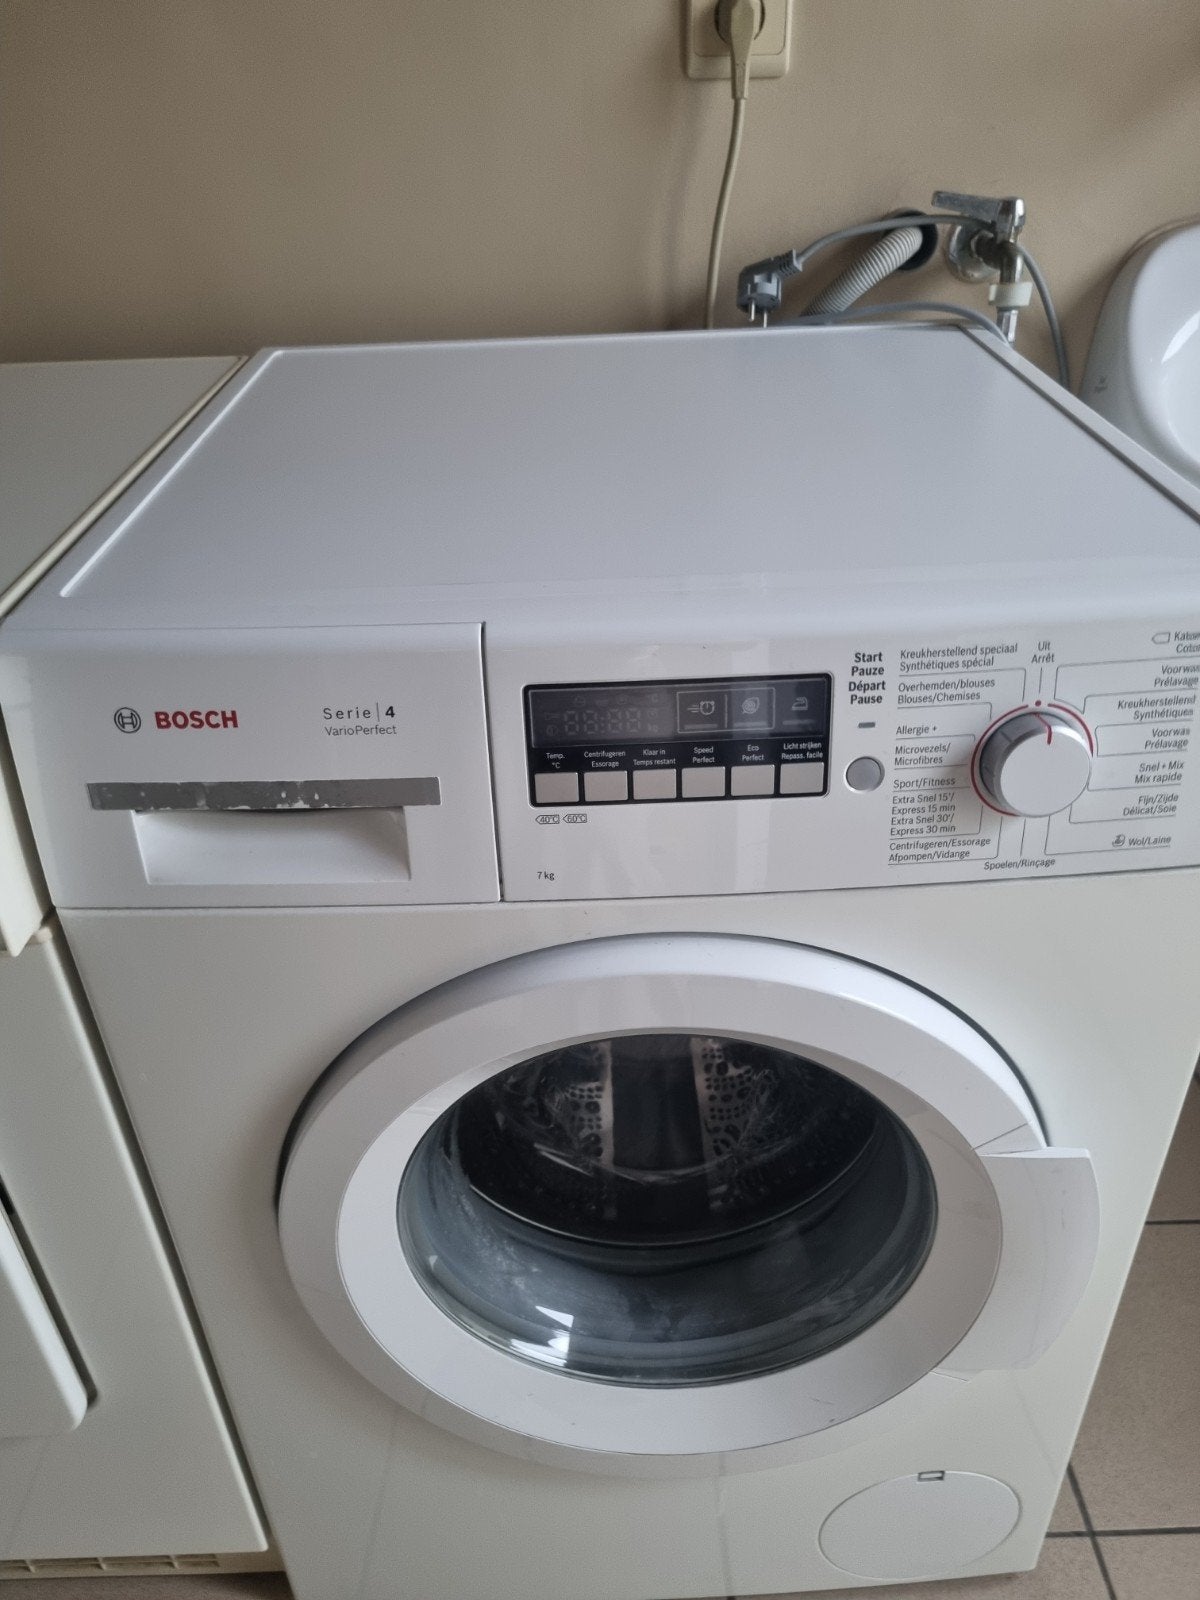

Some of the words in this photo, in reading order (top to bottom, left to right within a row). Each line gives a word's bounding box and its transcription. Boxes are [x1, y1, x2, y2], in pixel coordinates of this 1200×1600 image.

[900, 646, 978, 659] Kreukherstellend
[980, 643, 1018, 657] speciaal
[1038, 641, 1051, 651] Uit
[854, 652, 883, 663] Start
[1031, 653, 1055, 664] Arrêt
[900, 660, 960, 673] Synthétiques
[961, 657, 995, 670] spécial
[851, 665, 884, 677] Pauze
[848, 680, 886, 693] Départ
[898, 679, 995, 692] Overhemden/blouses
[1154, 676, 1199, 687] Prélavage
[850, 694, 883, 705] Pause
[897, 692, 981, 705] Blouses/Chemises
[1118, 695, 1196, 710] Kreukherstellend
[323, 706, 371, 720] Serie
[385, 706, 395, 718] 4
[1133, 709, 1194, 722] Synthétiques
[154, 710, 239, 729] BOSCH
[325, 724, 397, 736] VarioPerfect
[896, 726, 930, 737] Allergie
[1152, 728, 1190, 739] Voorwas
[747, 744, 760, 752] Eco
[783, 742, 799, 751] Licht
[800, 741, 822, 751] strijken
[895, 743, 951, 755] Microvezels/
[1145, 739, 1189, 750] Prélavage
[546, 752, 565, 761] Temp.
[584, 750, 626, 759] Centrifugeren
[643, 748, 658, 756] Klaar
[659, 748, 666, 756] in
[694, 747, 714, 756] Speed
[781, 752, 805, 761] Repass.
[806, 750, 823, 759] facile
[633, 758, 652, 768] Temps
[653, 758, 676, 766] restant
[692, 756, 715, 764] Perfect
[742, 754, 765, 762] Perfect
[894, 757, 943, 767] Microfibres
[591, 761, 620, 769] Essorage
[1139, 763, 1159, 773] Snel
[1169, 761, 1184, 771] Mix
[893, 778, 956, 790] Sport/Fitness
[1135, 773, 1150, 784] Mix
[1152, 772, 1182, 785] rapide
[892, 796, 916, 805] Extra
[918, 794, 936, 803] Snel
[1138, 793, 1179, 805] Fijn/Zijde
[891, 806, 926, 817] Express
[928, 804, 938, 813] 15
[940, 803, 956, 812] min
[1123, 804, 1177, 816] Délicat/Soie
[891, 817, 914, 826] Extra
[916, 815, 934, 824] Snel
[890, 827, 924, 839] Express
[926, 825, 937, 834] 30
[940, 824, 956, 833] min
[889, 837, 991, 851] Centrifugeren/Essorage
[1128, 835, 1172, 846] Wol/Laine
[888, 850, 970, 863] Afpompen/Vidange
[984, 857, 1056, 872] Spoelen/Rinçage
[544, 871, 554, 881] kg
